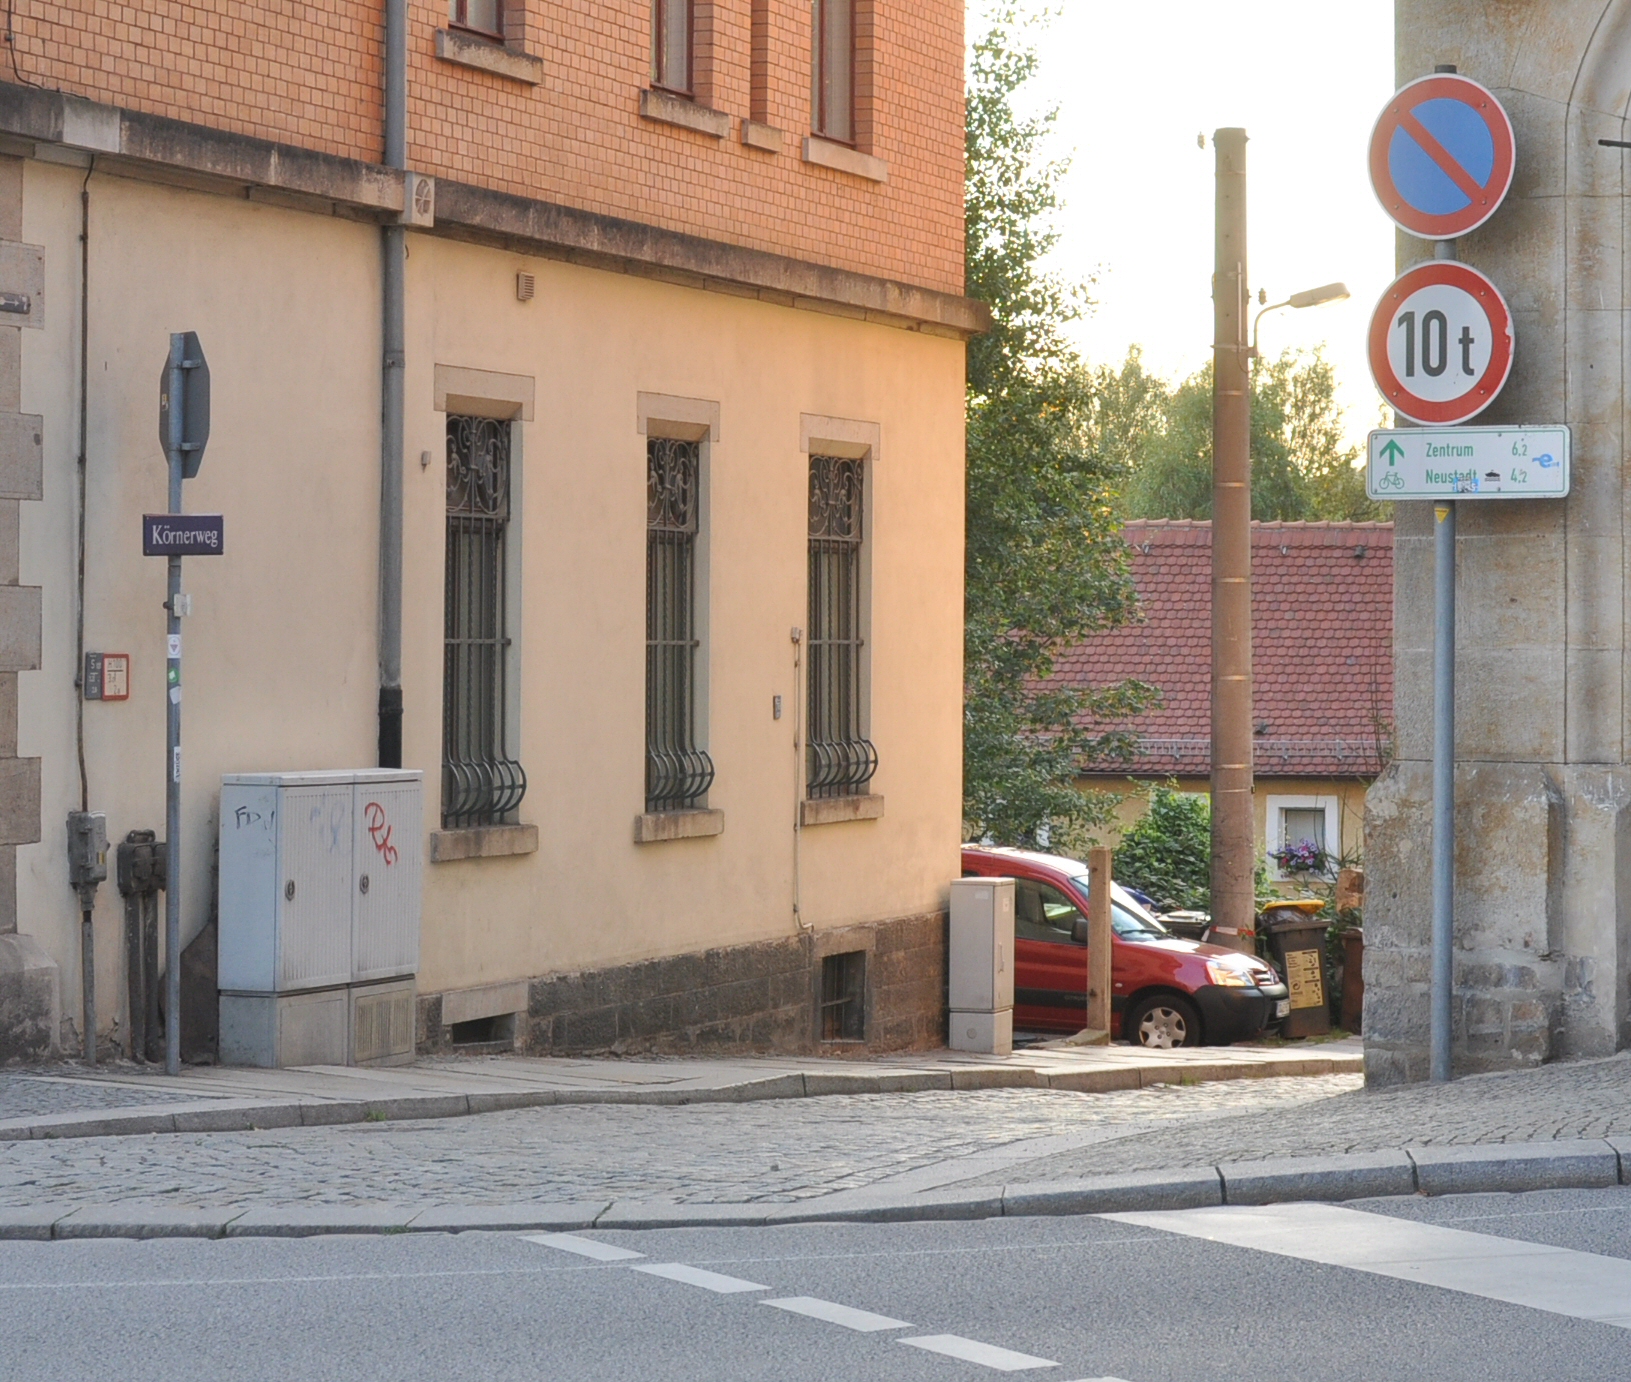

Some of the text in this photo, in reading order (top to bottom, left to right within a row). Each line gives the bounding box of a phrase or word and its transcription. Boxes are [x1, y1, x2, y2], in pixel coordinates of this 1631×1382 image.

[1398, 310, 1475, 377] 10 t
[1426, 443, 1474, 458] Zentrum
[1425, 468, 1477, 484] Neustadt
[152, 525, 218, 548] Körnerweg
